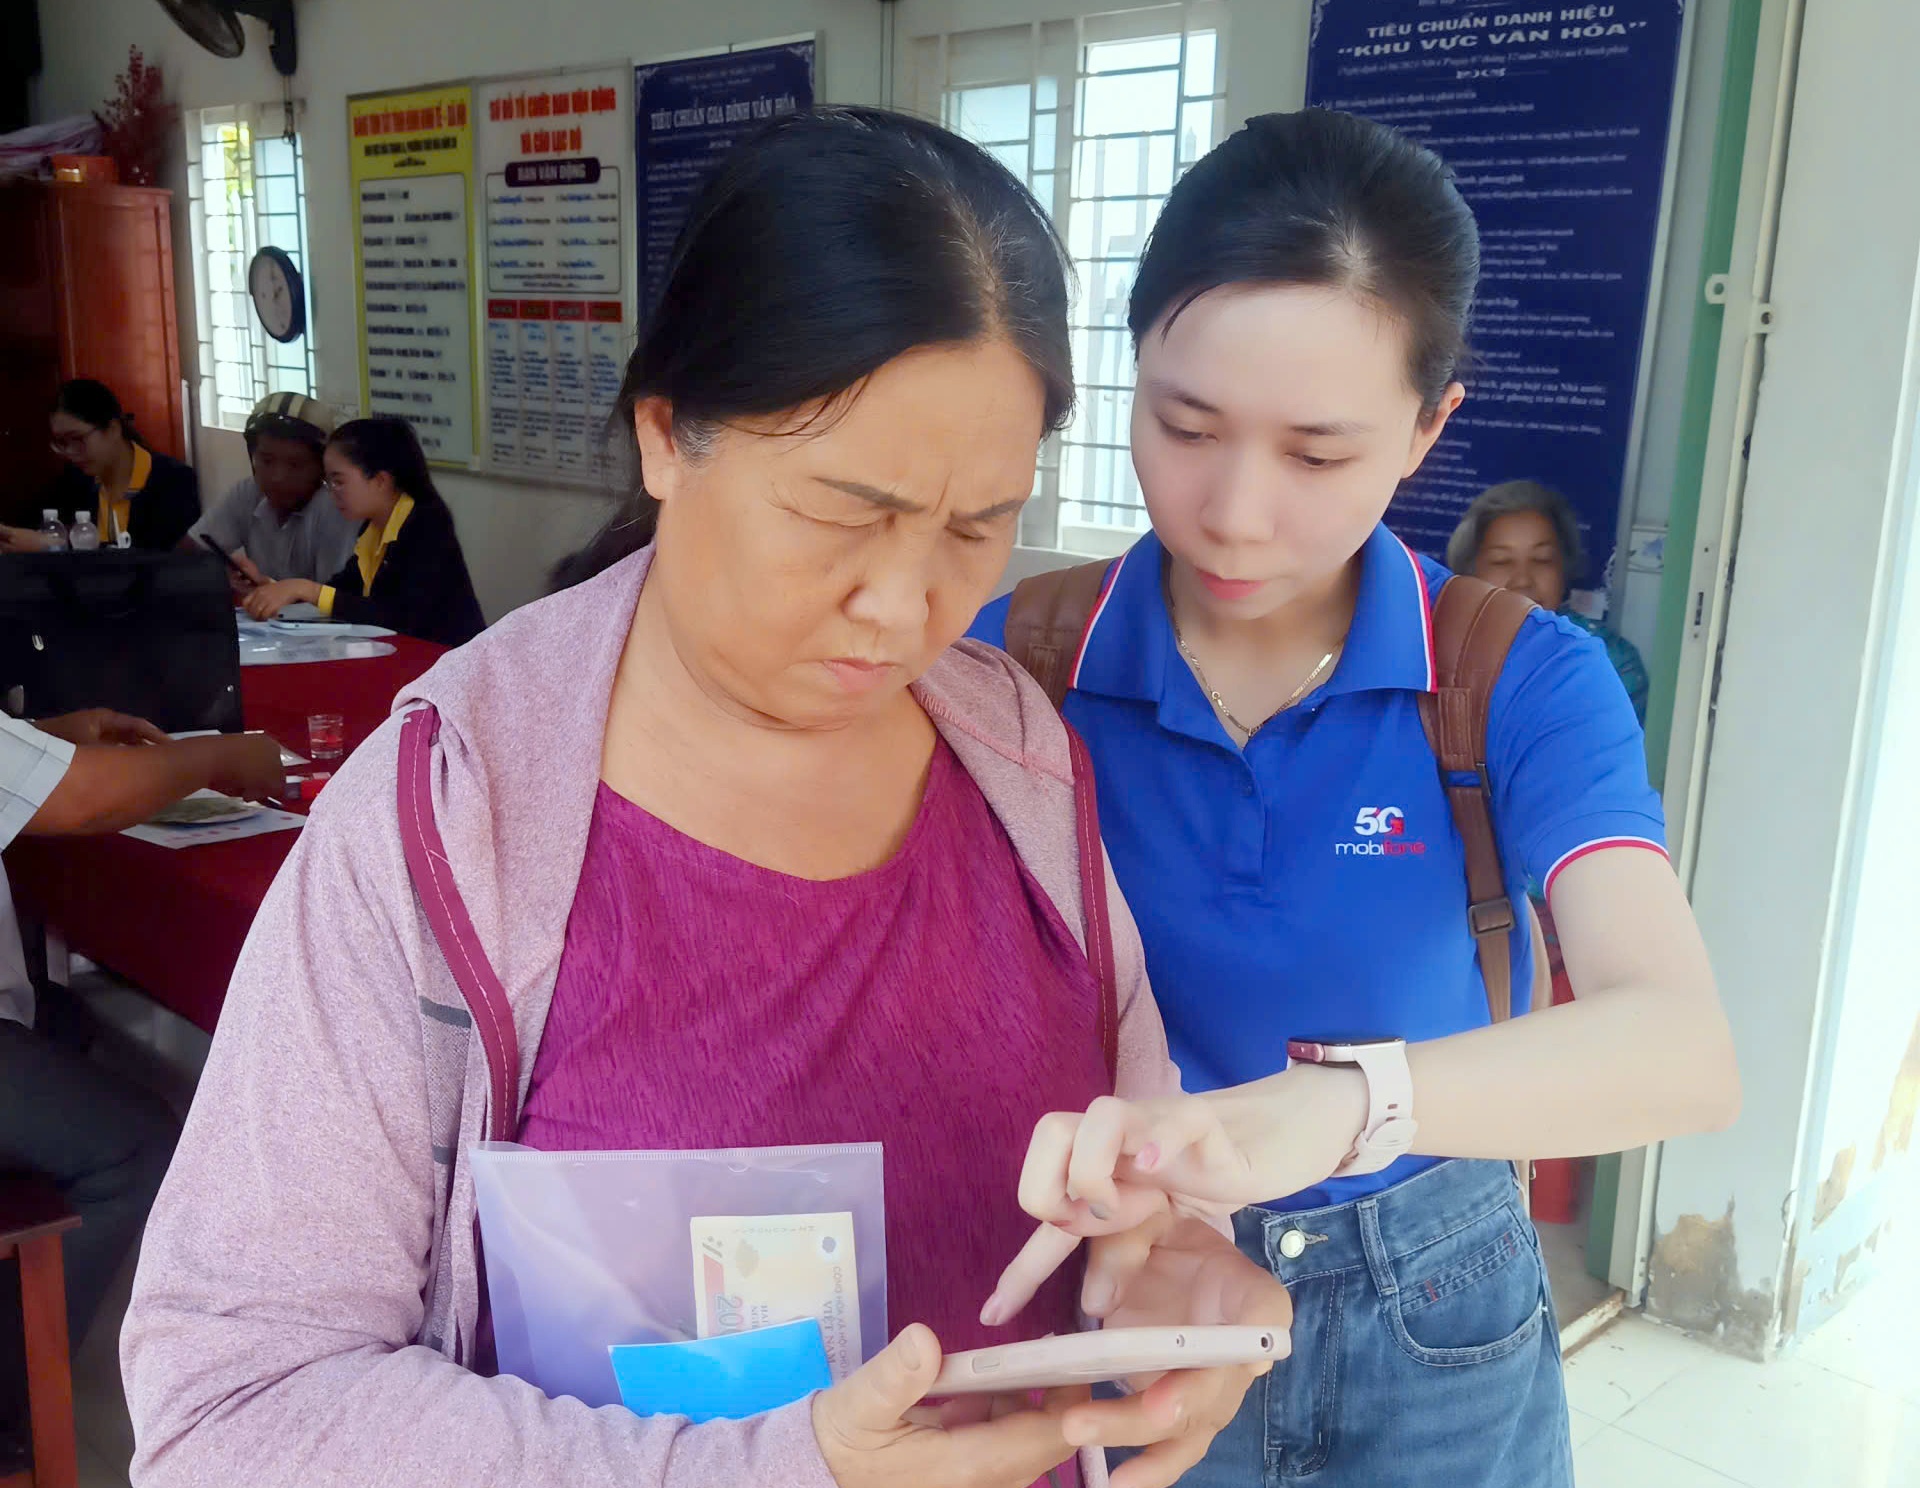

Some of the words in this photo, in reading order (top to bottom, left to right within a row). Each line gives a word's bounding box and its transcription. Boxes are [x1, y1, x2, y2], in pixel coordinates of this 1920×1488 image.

[1367, 21, 1412, 39] TIÊU
[1417, 12, 1488, 34] CHUẨN
[1493, 11, 1553, 27] DANH
[1559, 4, 1615, 22] HIỆU
[1420, 34, 1479, 51] VỰC
[1488, 28, 1549, 45] VĂN
[1353, 806, 1405, 836] 5G
[1335, 840, 1426, 856] mobifone
